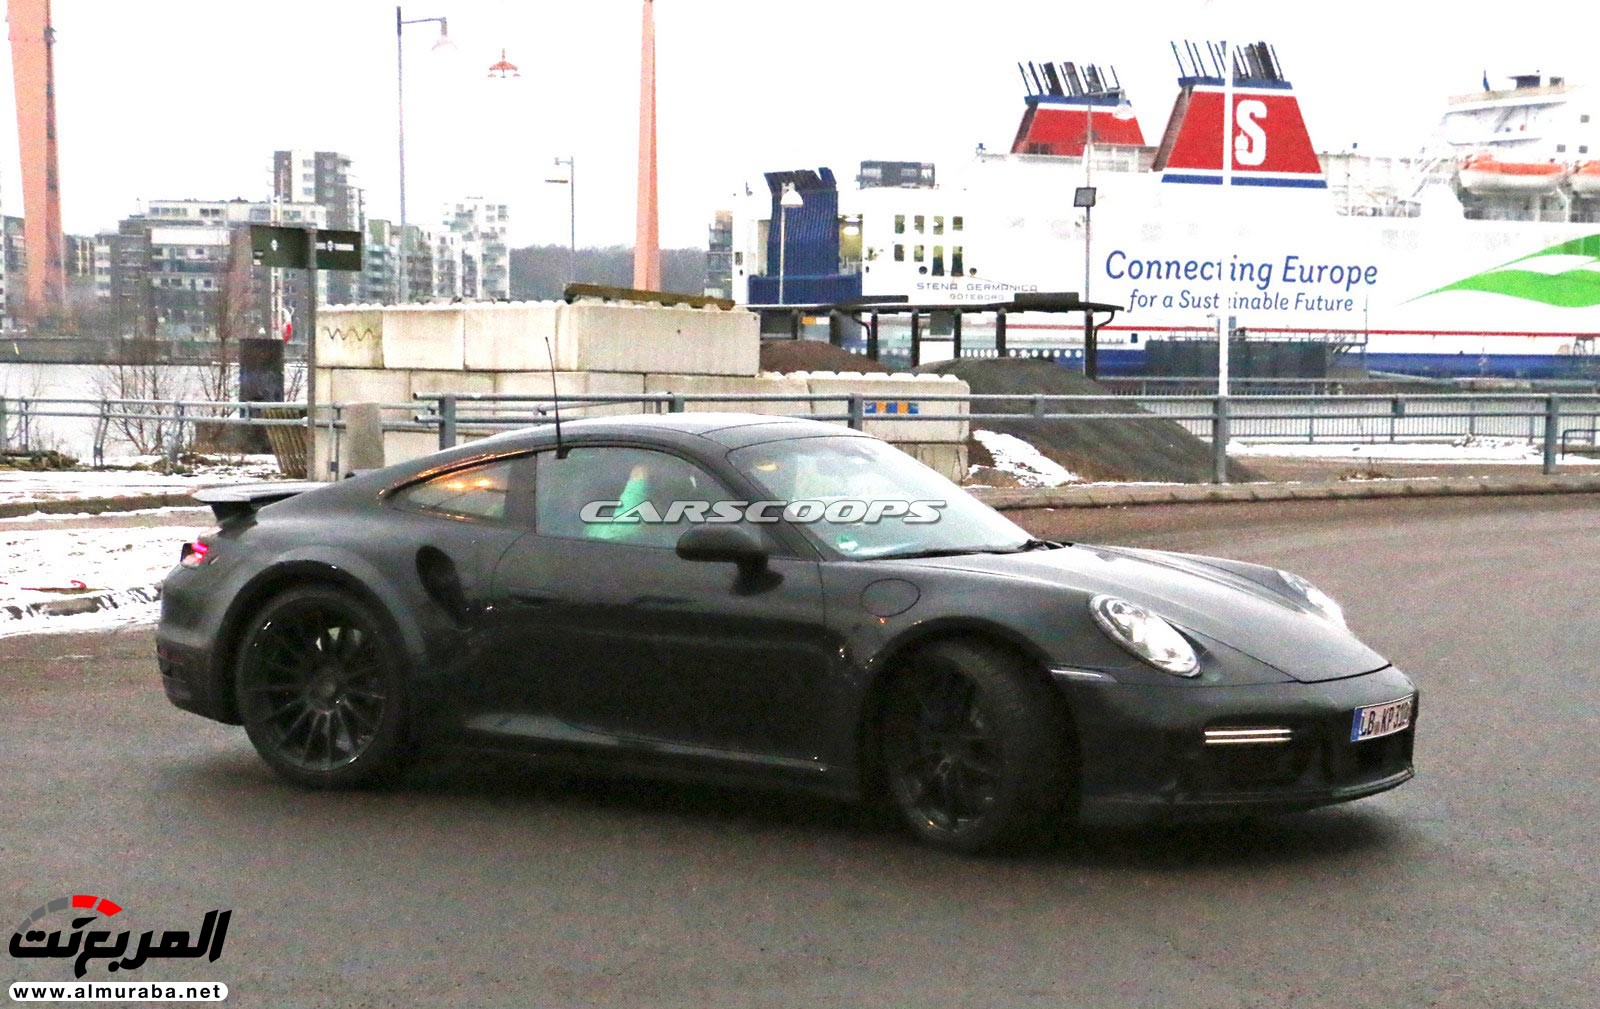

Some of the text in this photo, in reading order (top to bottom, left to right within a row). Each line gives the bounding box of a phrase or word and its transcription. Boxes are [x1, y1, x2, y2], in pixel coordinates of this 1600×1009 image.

[1235, 99, 1267, 166] S
[916, 282, 1038, 292] STENA GERMANICA
[1105, 250, 1378, 291] Connecting Europe
[1127, 288, 1354, 313] for a Sustinable Future
